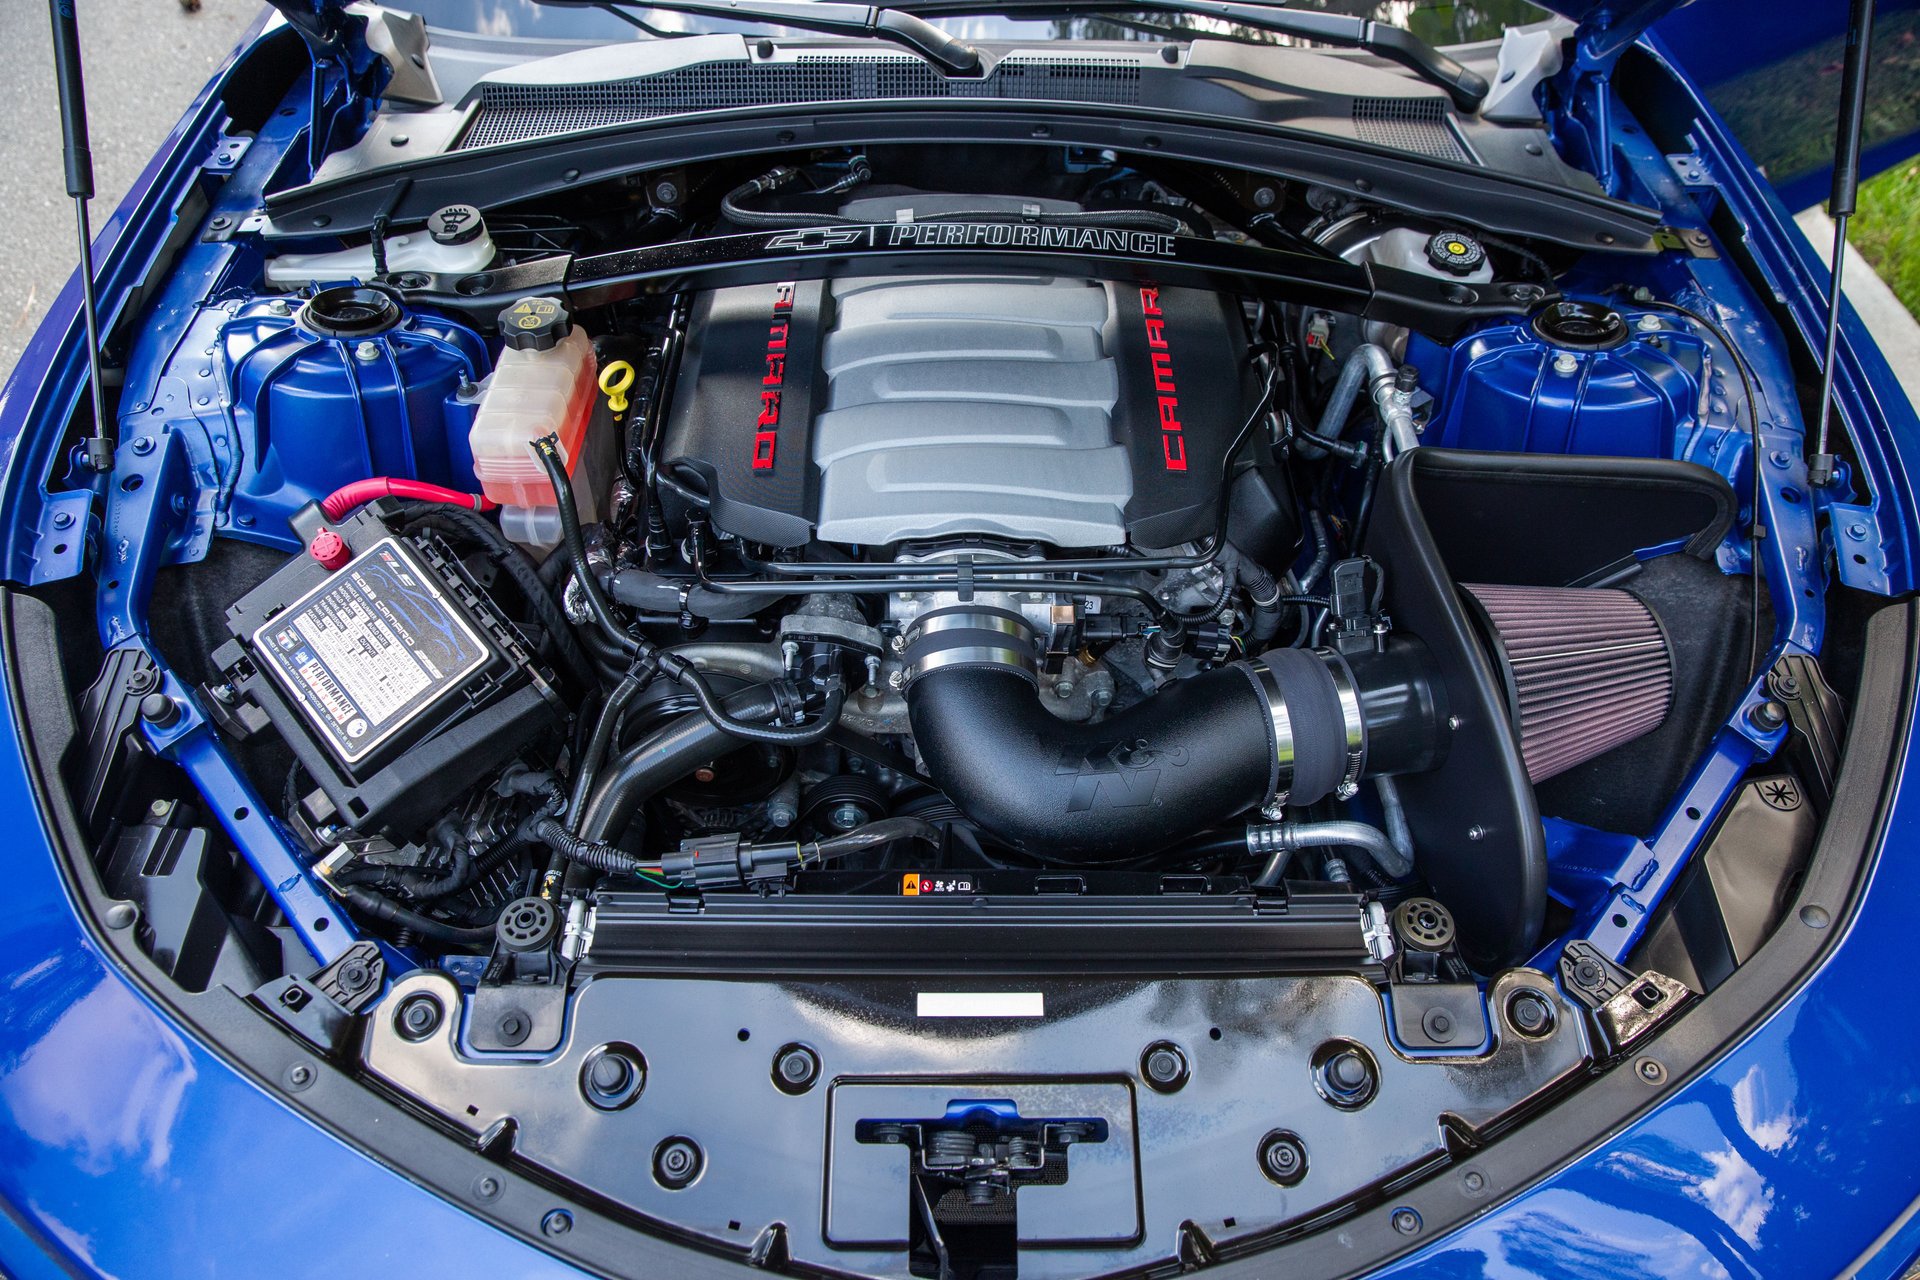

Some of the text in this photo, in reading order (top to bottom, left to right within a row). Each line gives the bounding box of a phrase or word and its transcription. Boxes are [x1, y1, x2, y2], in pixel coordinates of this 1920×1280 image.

[888, 224, 1177, 256] PERFORMANCE
[752, 282, 796, 471] AMARO
[1140, 288, 1188, 471] CAMAR
[312, 604, 325, 618] PAINT:
[318, 599, 346, 631] TRANSMISSION:
[324, 594, 340, 612] ENGINE:
[359, 637, 376, 656] OUTPUT:
[330, 590, 343, 604] BUILD
[340, 602, 354, 617] PLANT:
[337, 585, 352, 602] MODEL:
[366, 621, 379, 635] BUILD
[376, 633, 389, 647] DATE:
[391, 651, 409, 671] AUGUST
[343, 581, 359, 598] VEHICLE
[359, 601, 378, 621] NUMBER:
[350, 571, 377, 600] 2023
[374, 599, 415, 646] CAMARO
[300, 668, 345, 721] DIVISION
[307, 661, 354, 716] PERFORMANCE
